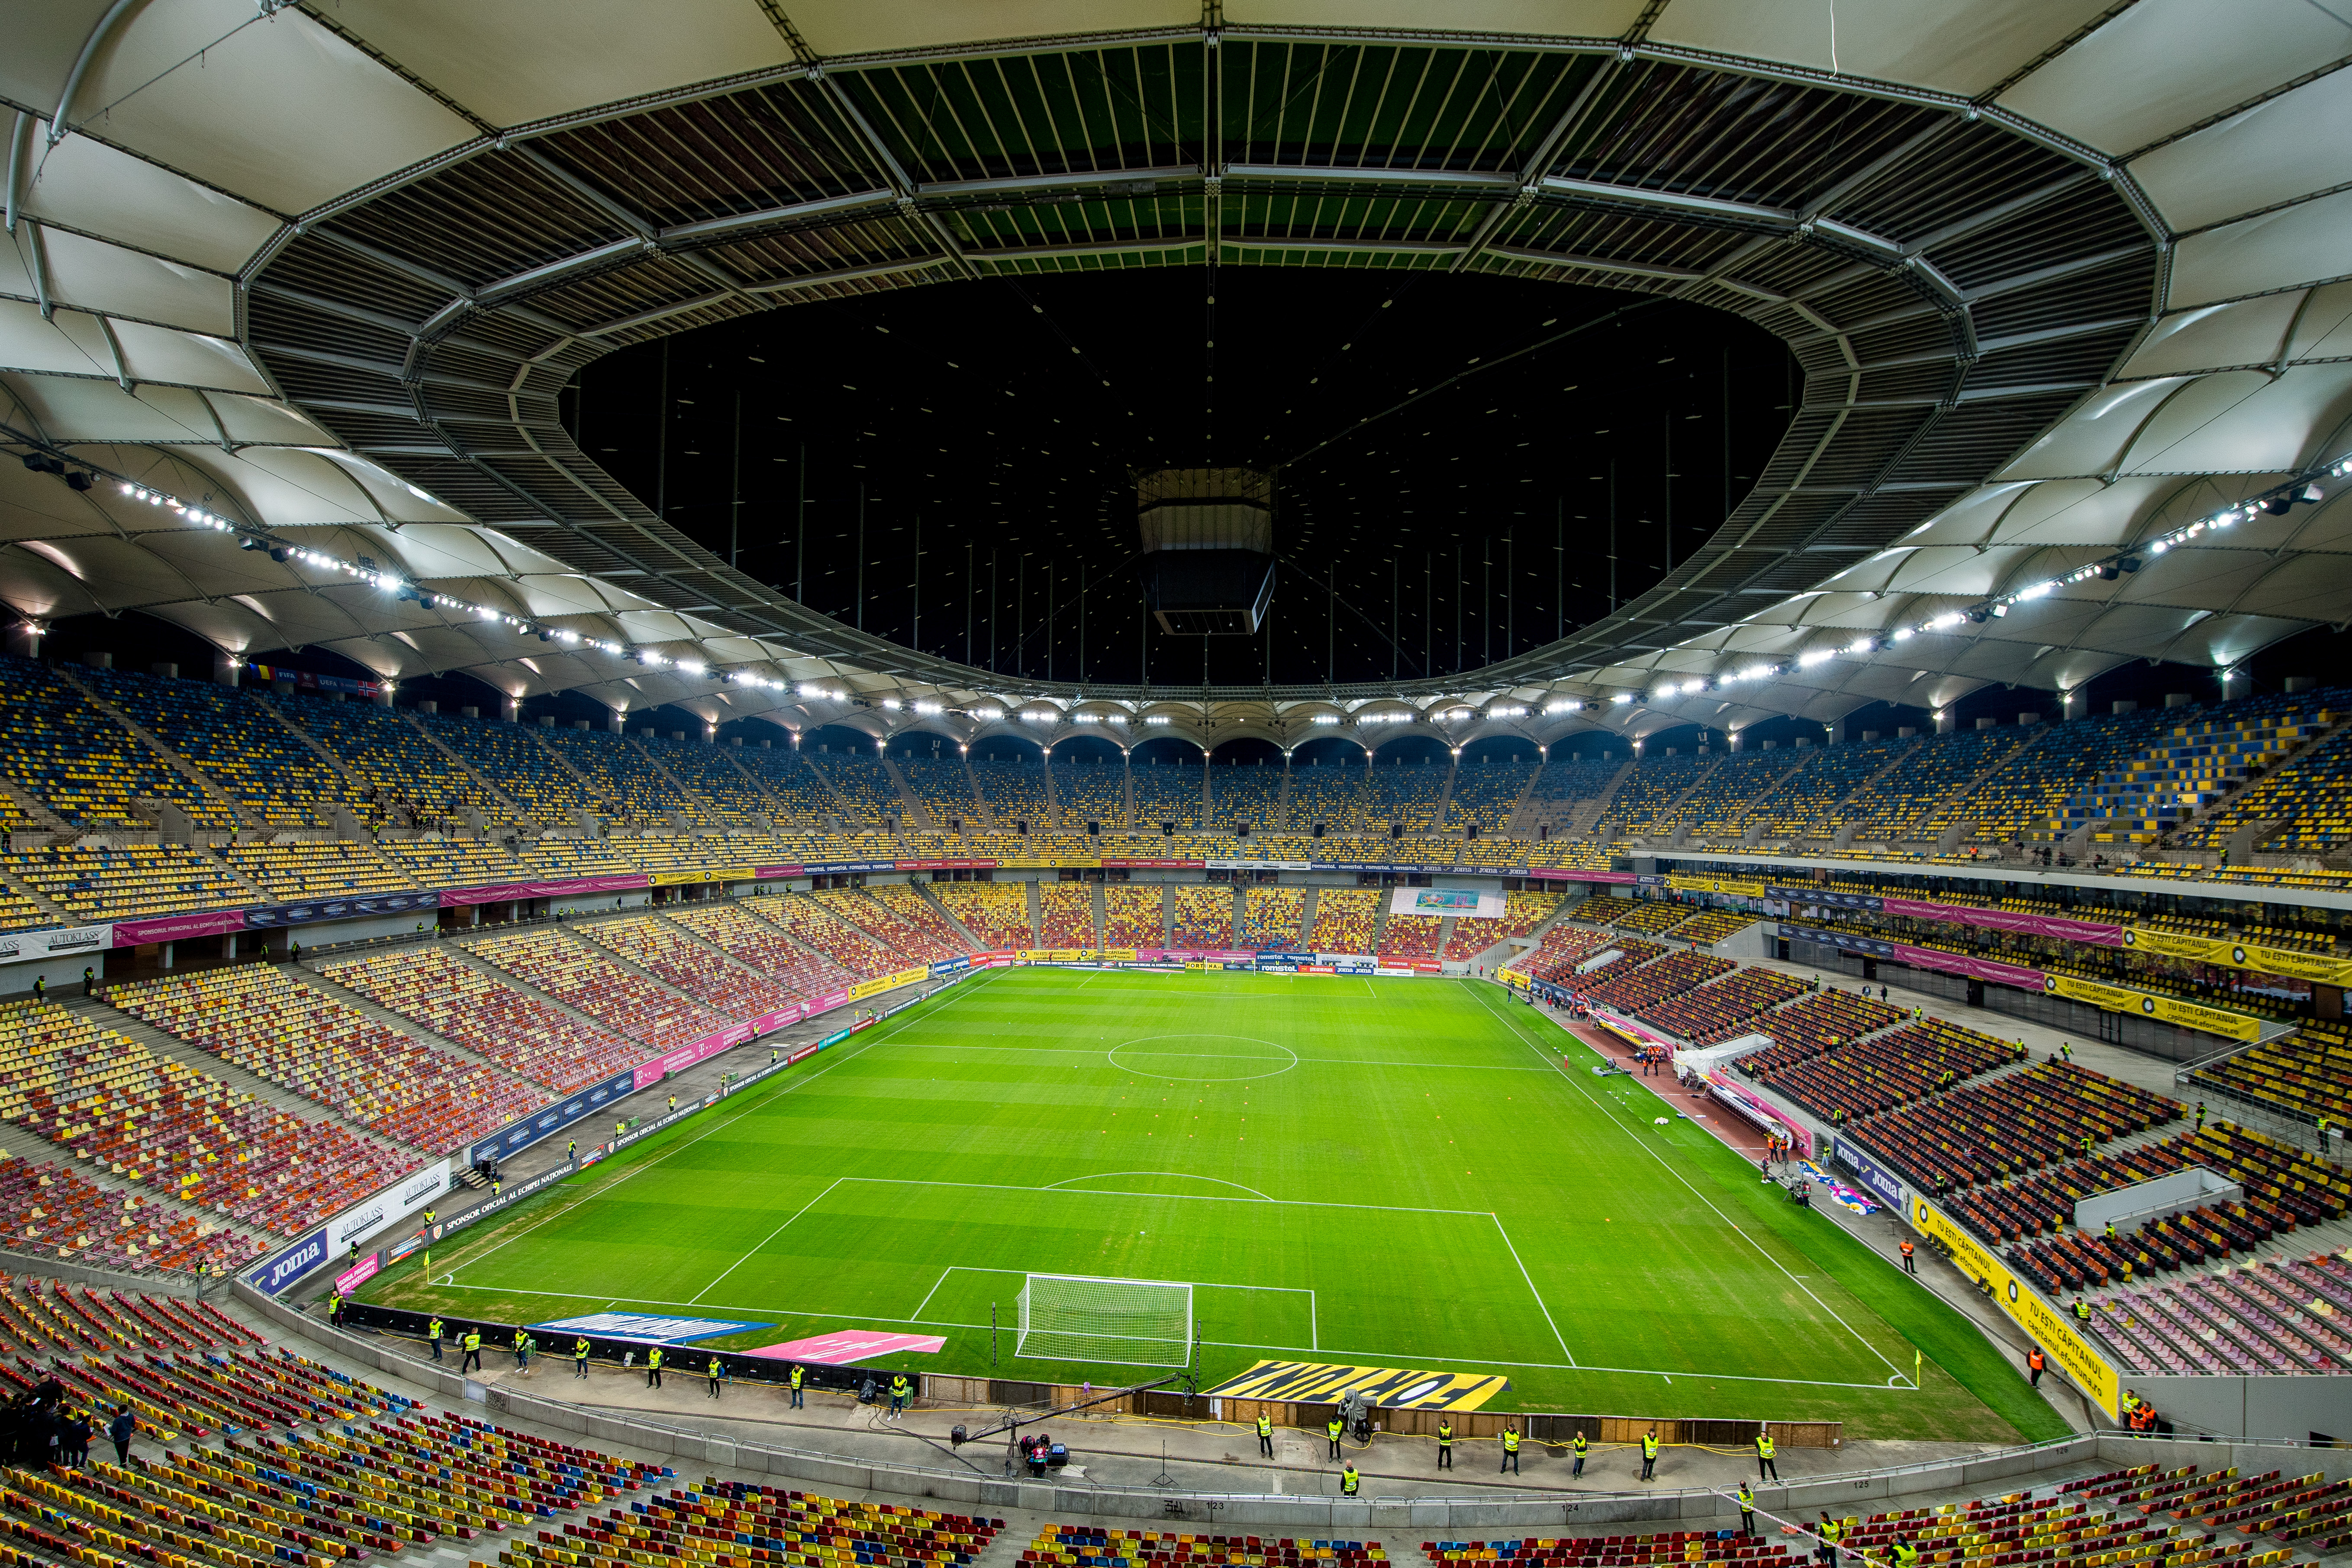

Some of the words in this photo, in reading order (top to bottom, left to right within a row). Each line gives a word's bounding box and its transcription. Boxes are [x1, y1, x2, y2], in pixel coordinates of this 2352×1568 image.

[49, 930, 99, 944] AUTOKLASS
[138, 927, 167, 936] SPONSORUL
[168, 924, 192, 933] PRINCIPAL
[2167, 1002, 2176, 1010] TU
[2178, 1005, 2193, 1014] EȘTI
[2194, 1008, 2238, 1025] CĂPITANUL
[723, 1031, 736, 1040] SPONSOR
[736, 1027, 749, 1035] PRINCIPAL
[2166, 1014, 2239, 1034] capitanul.efortuna.ro
[663, 1055, 678, 1065] SPONSOR
[678, 1049, 692, 1059] PRINCIPAL
[668, 1060, 680, 1070] ECHIPEI
[729, 1080, 745, 1091] SPONSOR
[761, 1067, 772, 1076] ECHIPEI
[1725, 1083, 1740, 1095] SPONSOR
[617, 1131, 638, 1147] SPONSOR
[639, 1122, 656, 1136] OFICIAL
[657, 1119, 662, 1127] AL
[663, 1112, 677, 1124] ECHIPEI
[678, 1102, 699, 1116] NAȚIONALE
[404, 1172, 440, 1200] AUTOKLASS
[447, 1209, 480, 1230] SPONSOR
[481, 1196, 507, 1213] OFICIAL
[508, 1191, 517, 1201] AL
[518, 1179, 540, 1195] ECHIPEI
[541, 1163, 573, 1183] NAȚIONALE
[341, 1204, 383, 1236] AUTOKLASS
[1937, 1220, 1944, 1232] TU
[1946, 1227, 1956, 1240] EȘTI
[1958, 1238, 1991, 1273] CĂPITANUL
[354, 1259, 375, 1277] PRINCIPAL
[2001, 1297, 2023, 1322] FORTUNA
[2030, 1301, 2039, 1317] TU
[2041, 1312, 2055, 1333] EȘTI
[2057, 1330, 2102, 1380] CĂPITANUL
[2028, 1320, 2102, 1397] capitanul.efortuna.ro
[2056, 1446, 2068, 1455] 126
[1853, 1480, 1869, 1489] 125
[1206, 1501, 1224, 1510] 123
